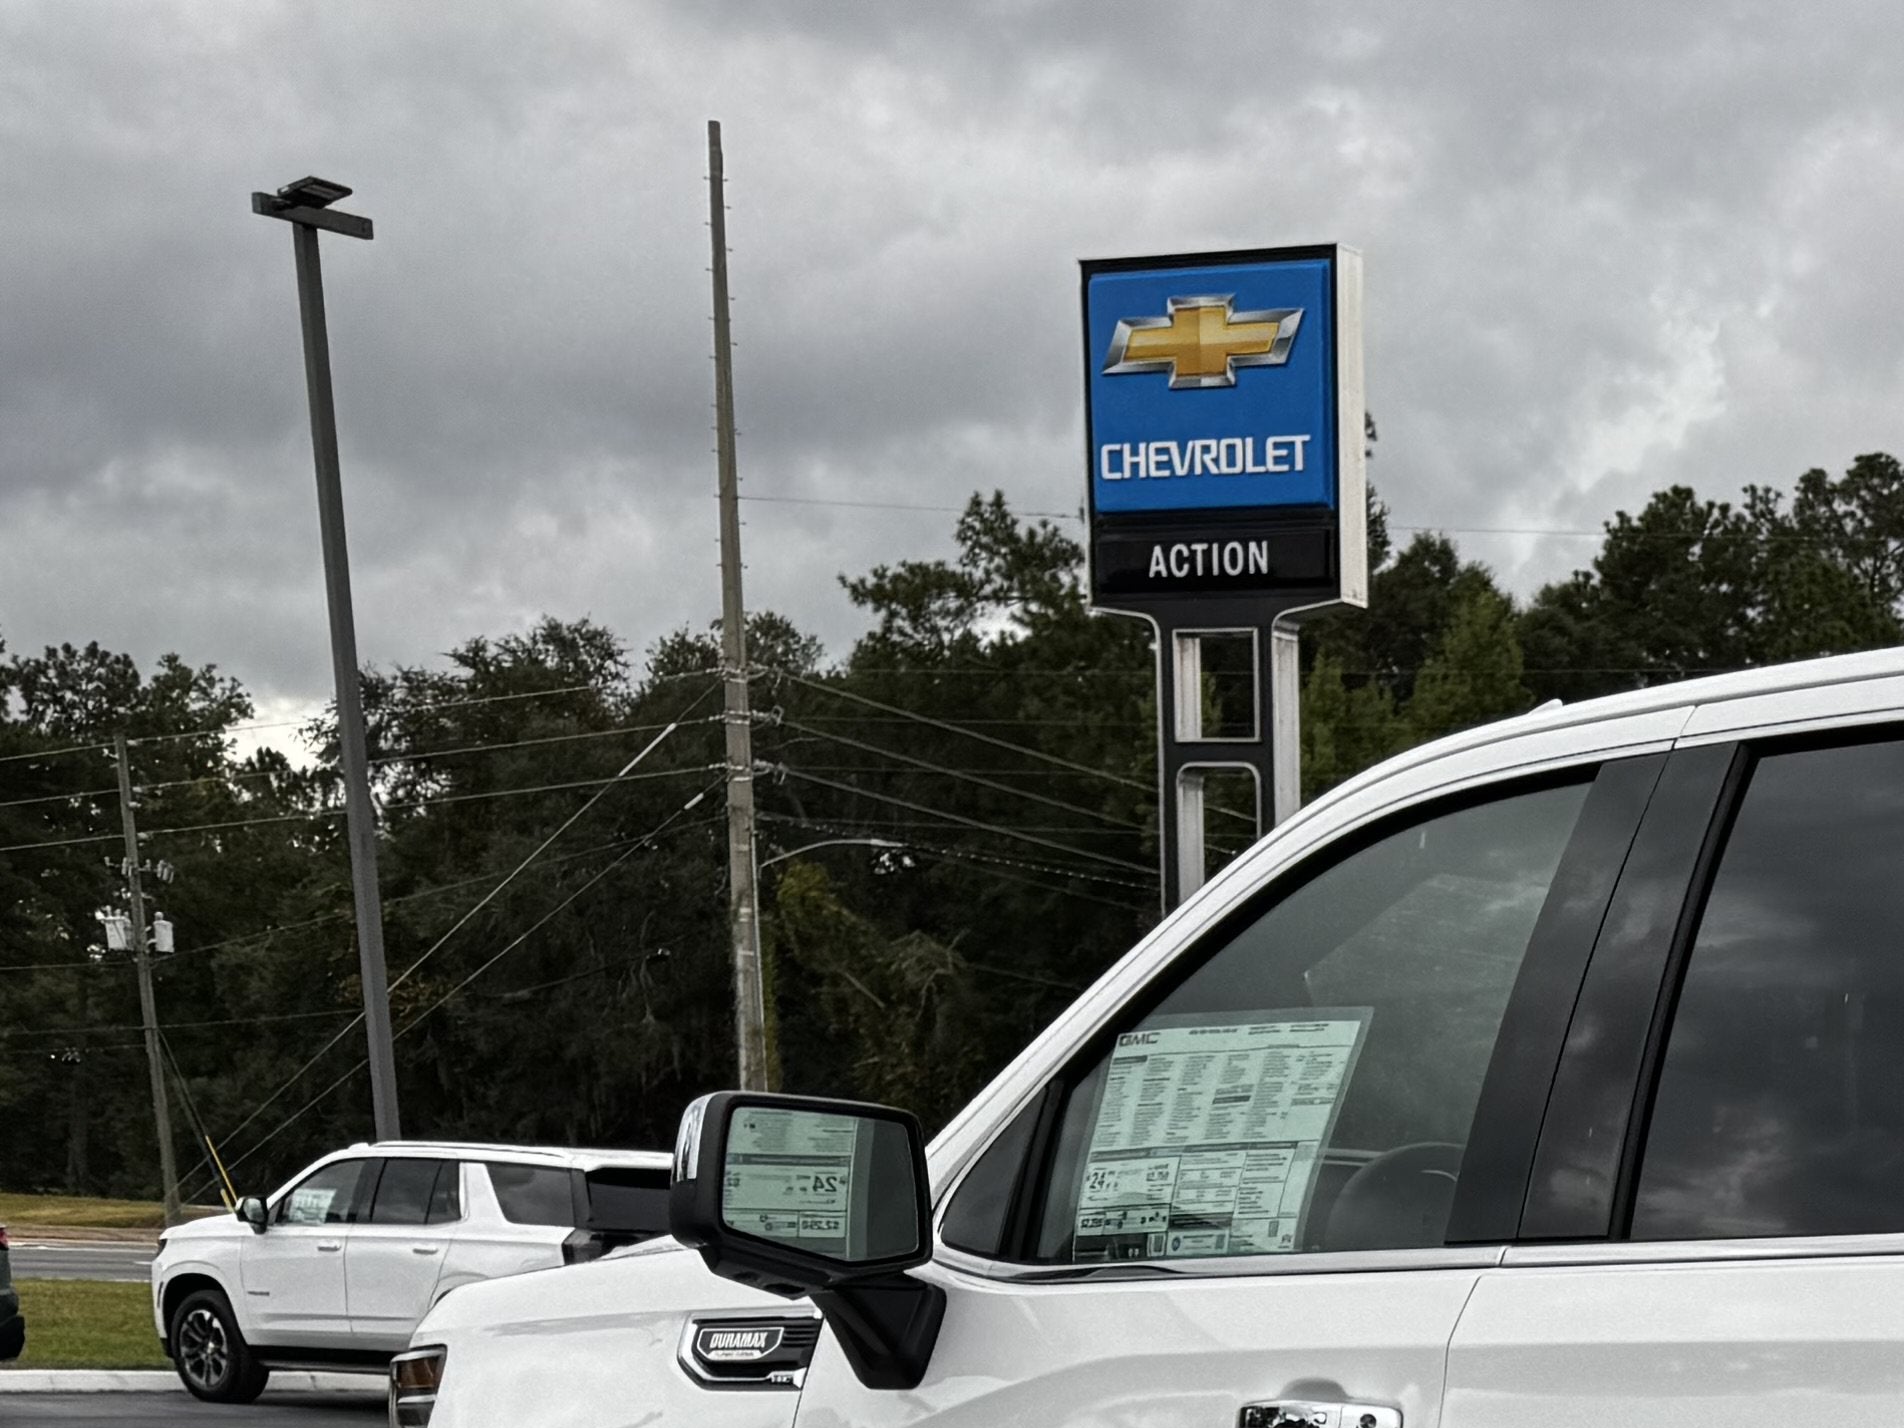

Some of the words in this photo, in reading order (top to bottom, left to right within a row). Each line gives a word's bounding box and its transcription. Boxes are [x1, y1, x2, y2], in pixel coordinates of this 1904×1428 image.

[1101, 435, 1311, 480] CHEVROLET
[1149, 541, 1269, 578] ACTION
[709, 1332, 768, 1349] DURAMAX
